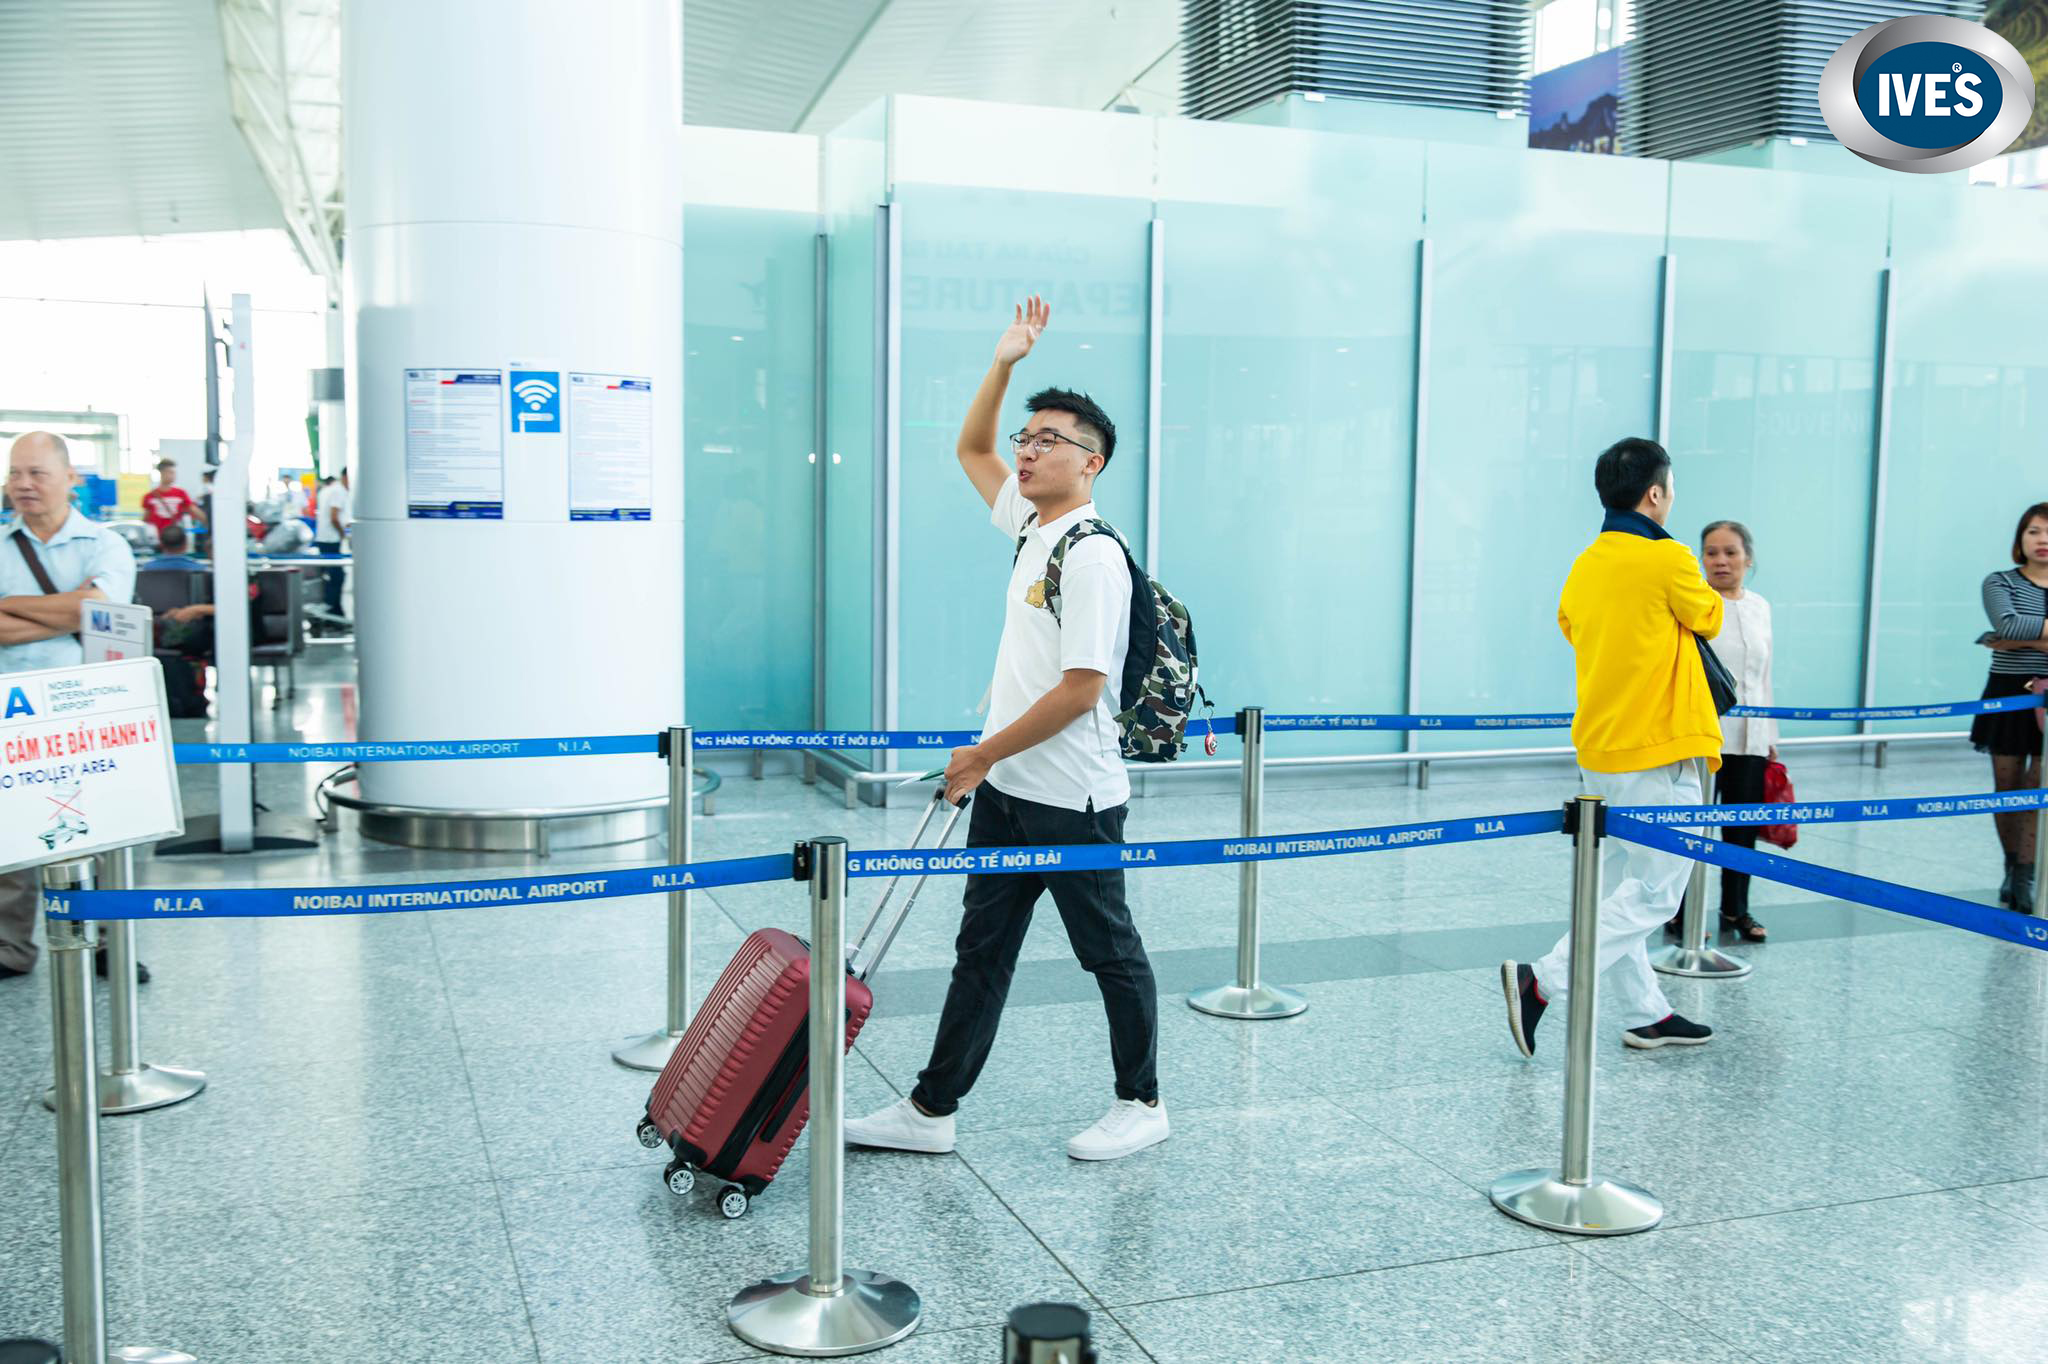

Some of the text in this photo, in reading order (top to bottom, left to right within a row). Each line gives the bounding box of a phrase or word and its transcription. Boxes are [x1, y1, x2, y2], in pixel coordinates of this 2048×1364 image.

[52, 699, 97, 713] AIRPORT
[1507, 717, 1573, 726] INTERNATIONA
[44, 734, 64, 759] XE
[289, 746, 339, 759] NOIBAI
[342, 745, 456, 758] INTERNATIONAL
[458, 742, 520, 755] AIRPORT
[558, 740, 592, 752] N.I.A
[18, 764, 76, 787] TROLLEY
[81, 758, 118, 775] AREA
[1695, 807, 1736, 823] KHÔNG
[1738, 805, 1772, 821] QUỐC
[1775, 805, 1790, 820] TẾ
[1917, 800, 1954, 813] NOIBAI
[1956, 795, 2040, 811] INTERNATIONAL
[864, 855, 924, 871] KHÔNG
[928, 850, 975, 870] QUỐC
[979, 849, 1000, 869] TẾ
[1003, 853, 1032, 871] NỘI
[1035, 849, 1062, 865] BÀI
[1120, 848, 1157, 862] N.I.A
[1223, 842, 1273, 856] NOIBAI
[1275, 835, 1385, 854] INTERNATIONAL
[1387, 827, 1444, 844] AIRPORT
[1475, 820, 1505, 834] N.I.A
[153, 897, 204, 912] N.I.A
[293, 894, 363, 910] NOIBAI
[368, 886, 521, 908] INTERNATIONAL
[528, 880, 608, 899] AIRPORT
[652, 872, 695, 888] N.I.A
